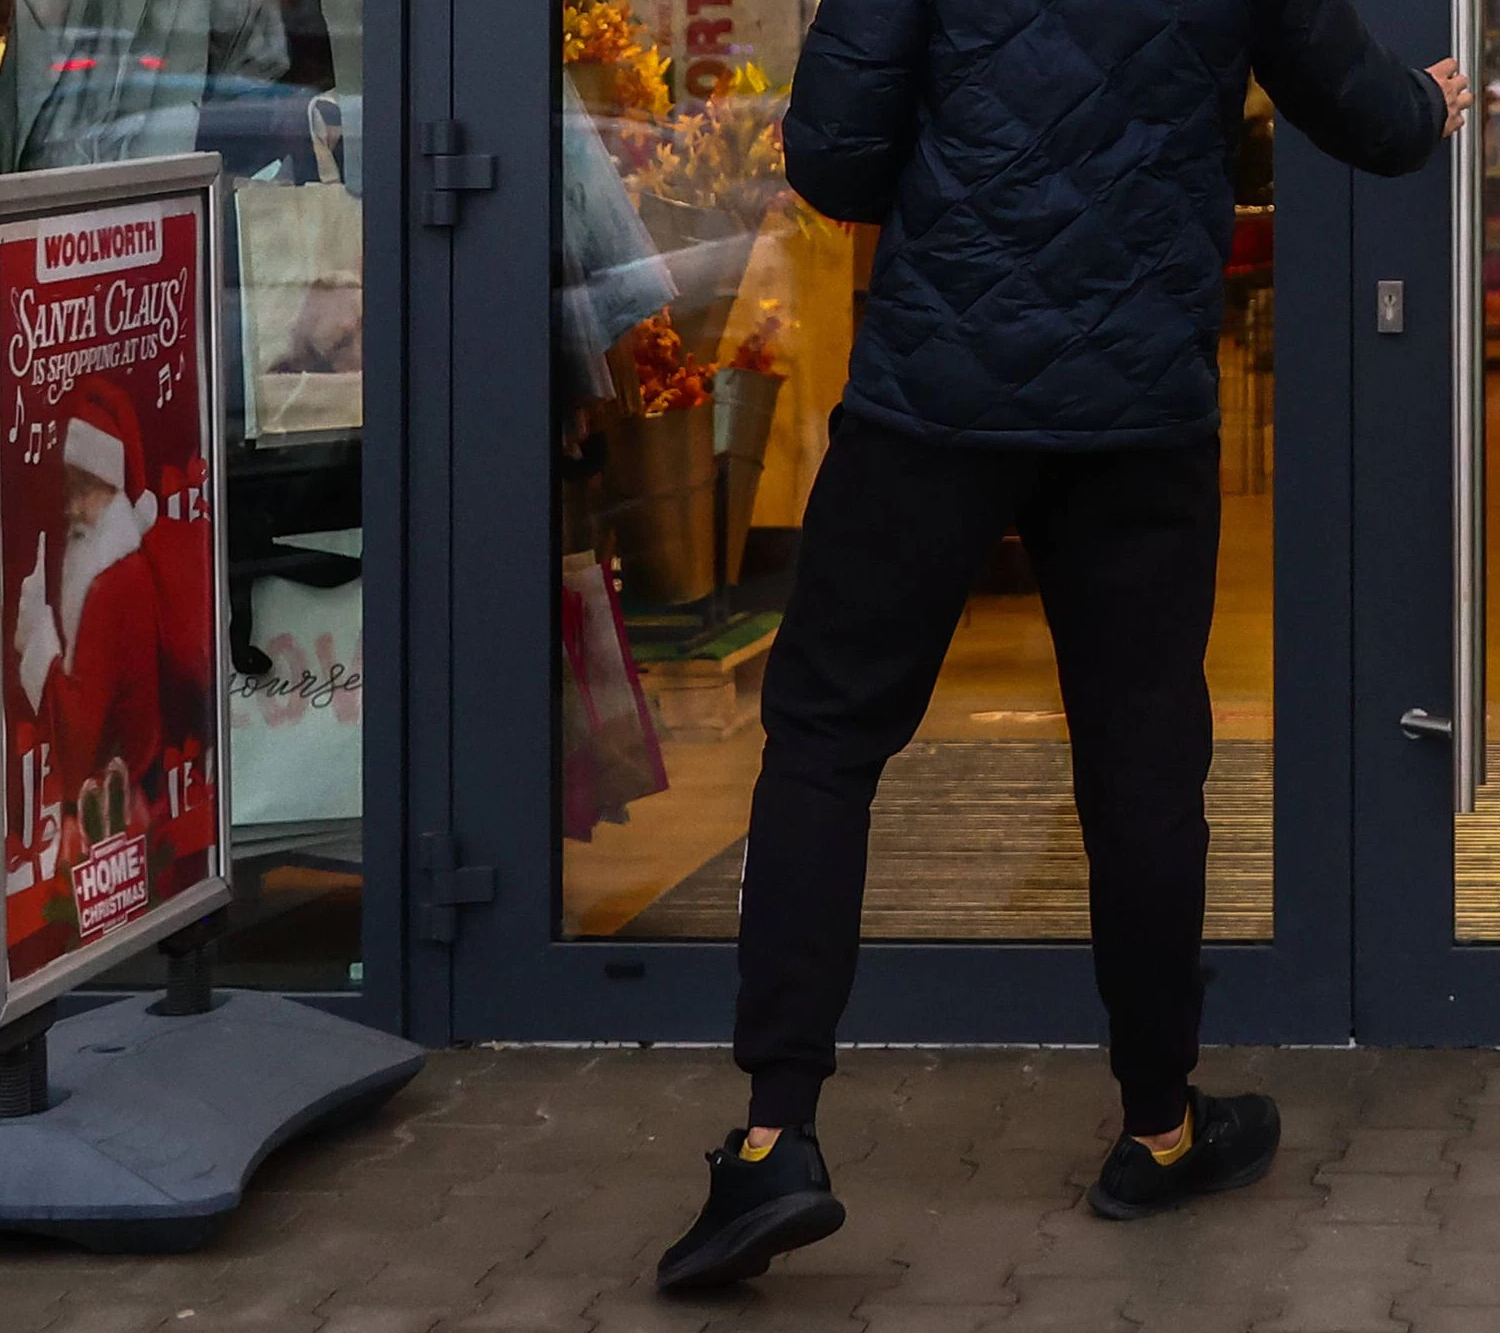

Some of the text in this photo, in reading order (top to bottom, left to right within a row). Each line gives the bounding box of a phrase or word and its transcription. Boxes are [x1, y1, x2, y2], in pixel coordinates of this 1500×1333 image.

[45, 221, 156, 269] WOOLWORTH
[31, 358, 46, 386] IS
[141, 333, 160, 360] US
[82, 844, 140, 901] HOME
[82, 880, 145, 929] CHRISTMAS
